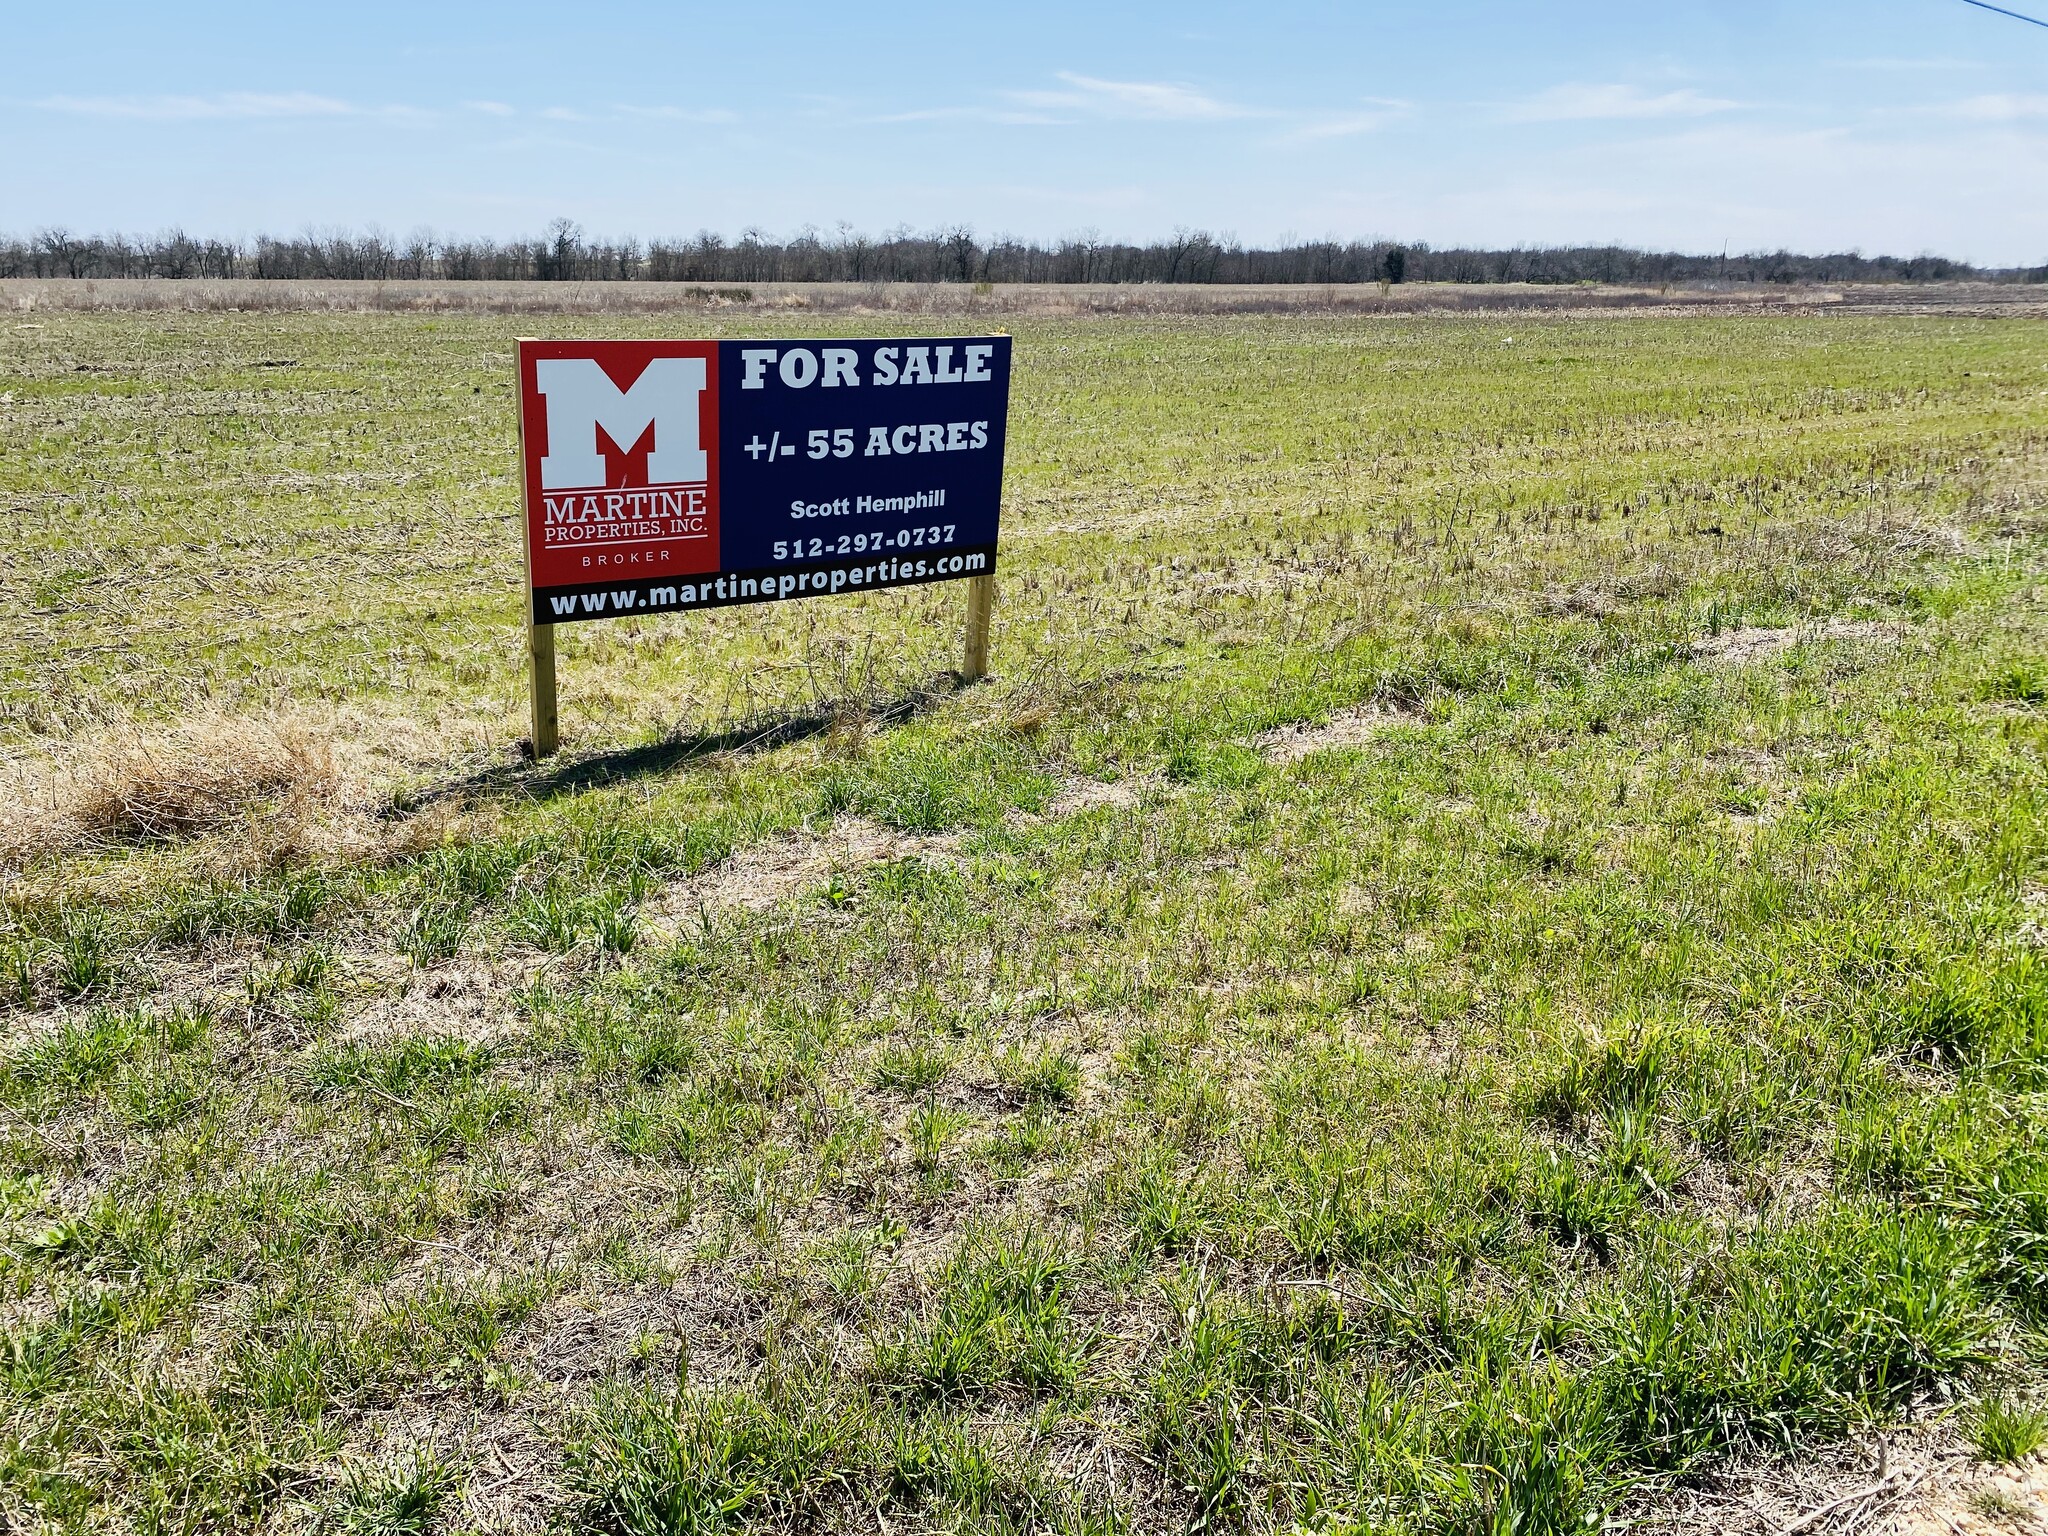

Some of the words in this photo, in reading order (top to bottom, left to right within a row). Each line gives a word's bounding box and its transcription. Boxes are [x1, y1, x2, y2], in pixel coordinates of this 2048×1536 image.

[741, 348, 860, 389] FOR
[873, 345, 993, 386] SALE
[536, 358, 707, 489] M
[744, 431, 795, 462] +/-
[807, 428, 854, 459] 55
[864, 420, 988, 457] ACRES
[543, 489, 707, 525] MARTINE
[790, 498, 850, 519] Scott
[856, 489, 946, 513] Hemphill
[544, 521, 665, 542] PROPERTIES,
[670, 518, 708, 532] INC.
[773, 525, 956, 560] 512-297-0737
[582, 550, 670, 567] BROKER
[550, 552, 986, 615] www.martineproperties.com
